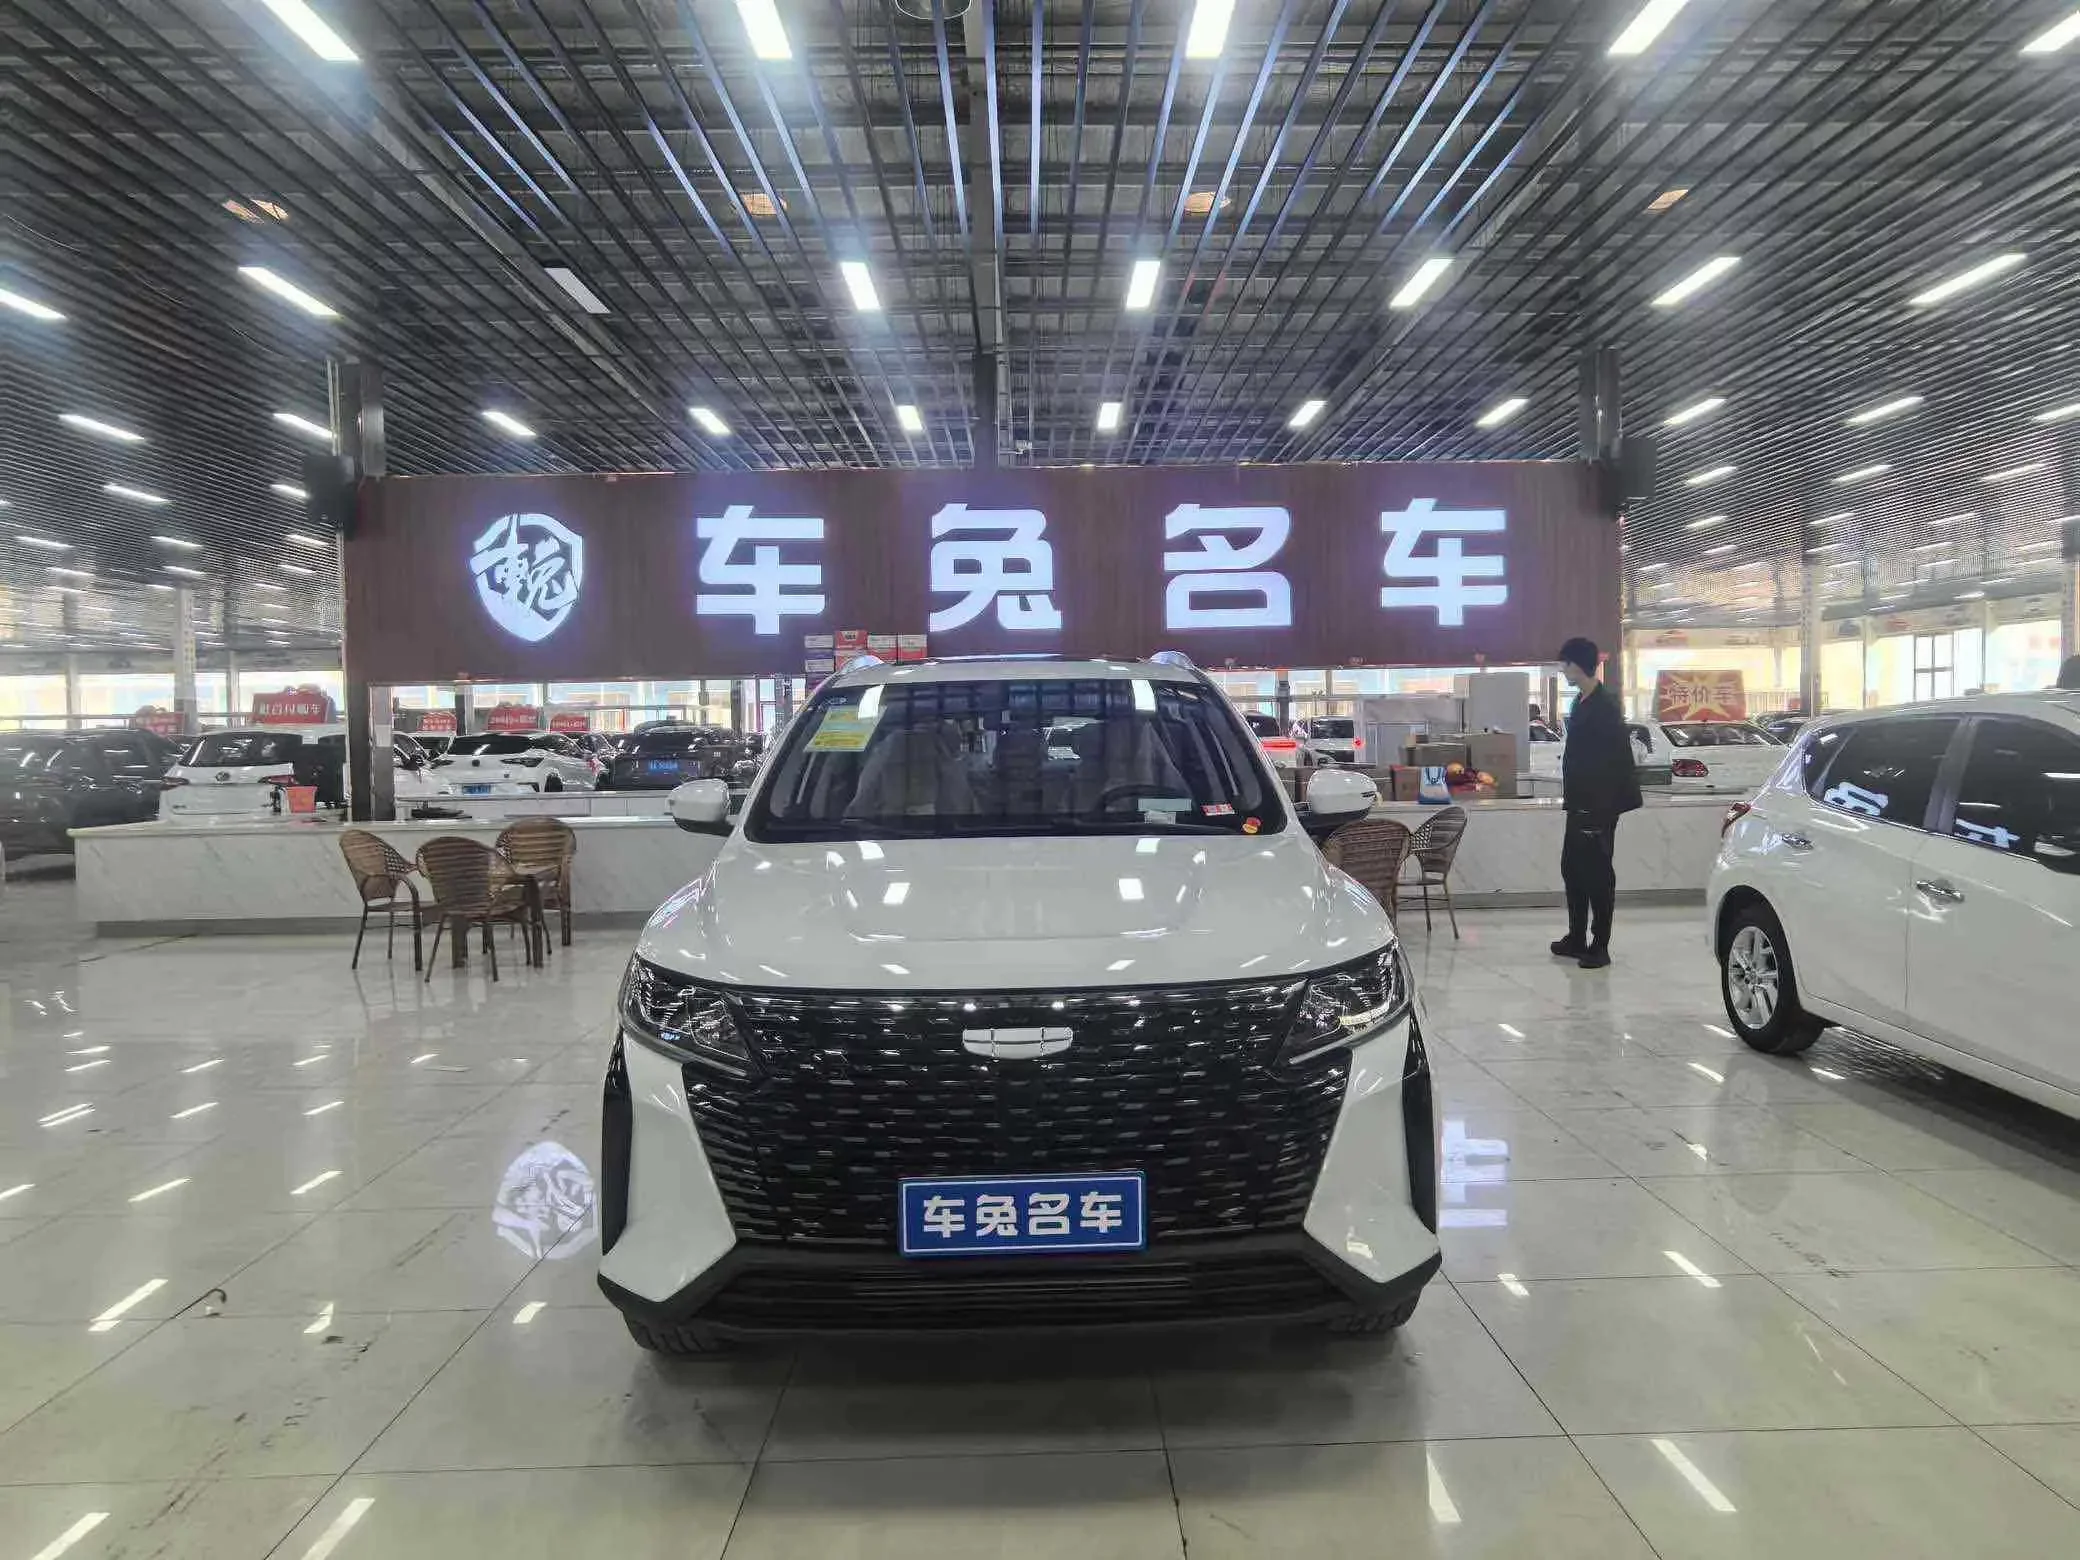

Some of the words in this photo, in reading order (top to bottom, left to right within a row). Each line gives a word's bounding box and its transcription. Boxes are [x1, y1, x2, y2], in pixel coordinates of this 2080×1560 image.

[695, 498, 1509, 634] 车兔名车
[923, 1191, 1122, 1238] 车兔名车
